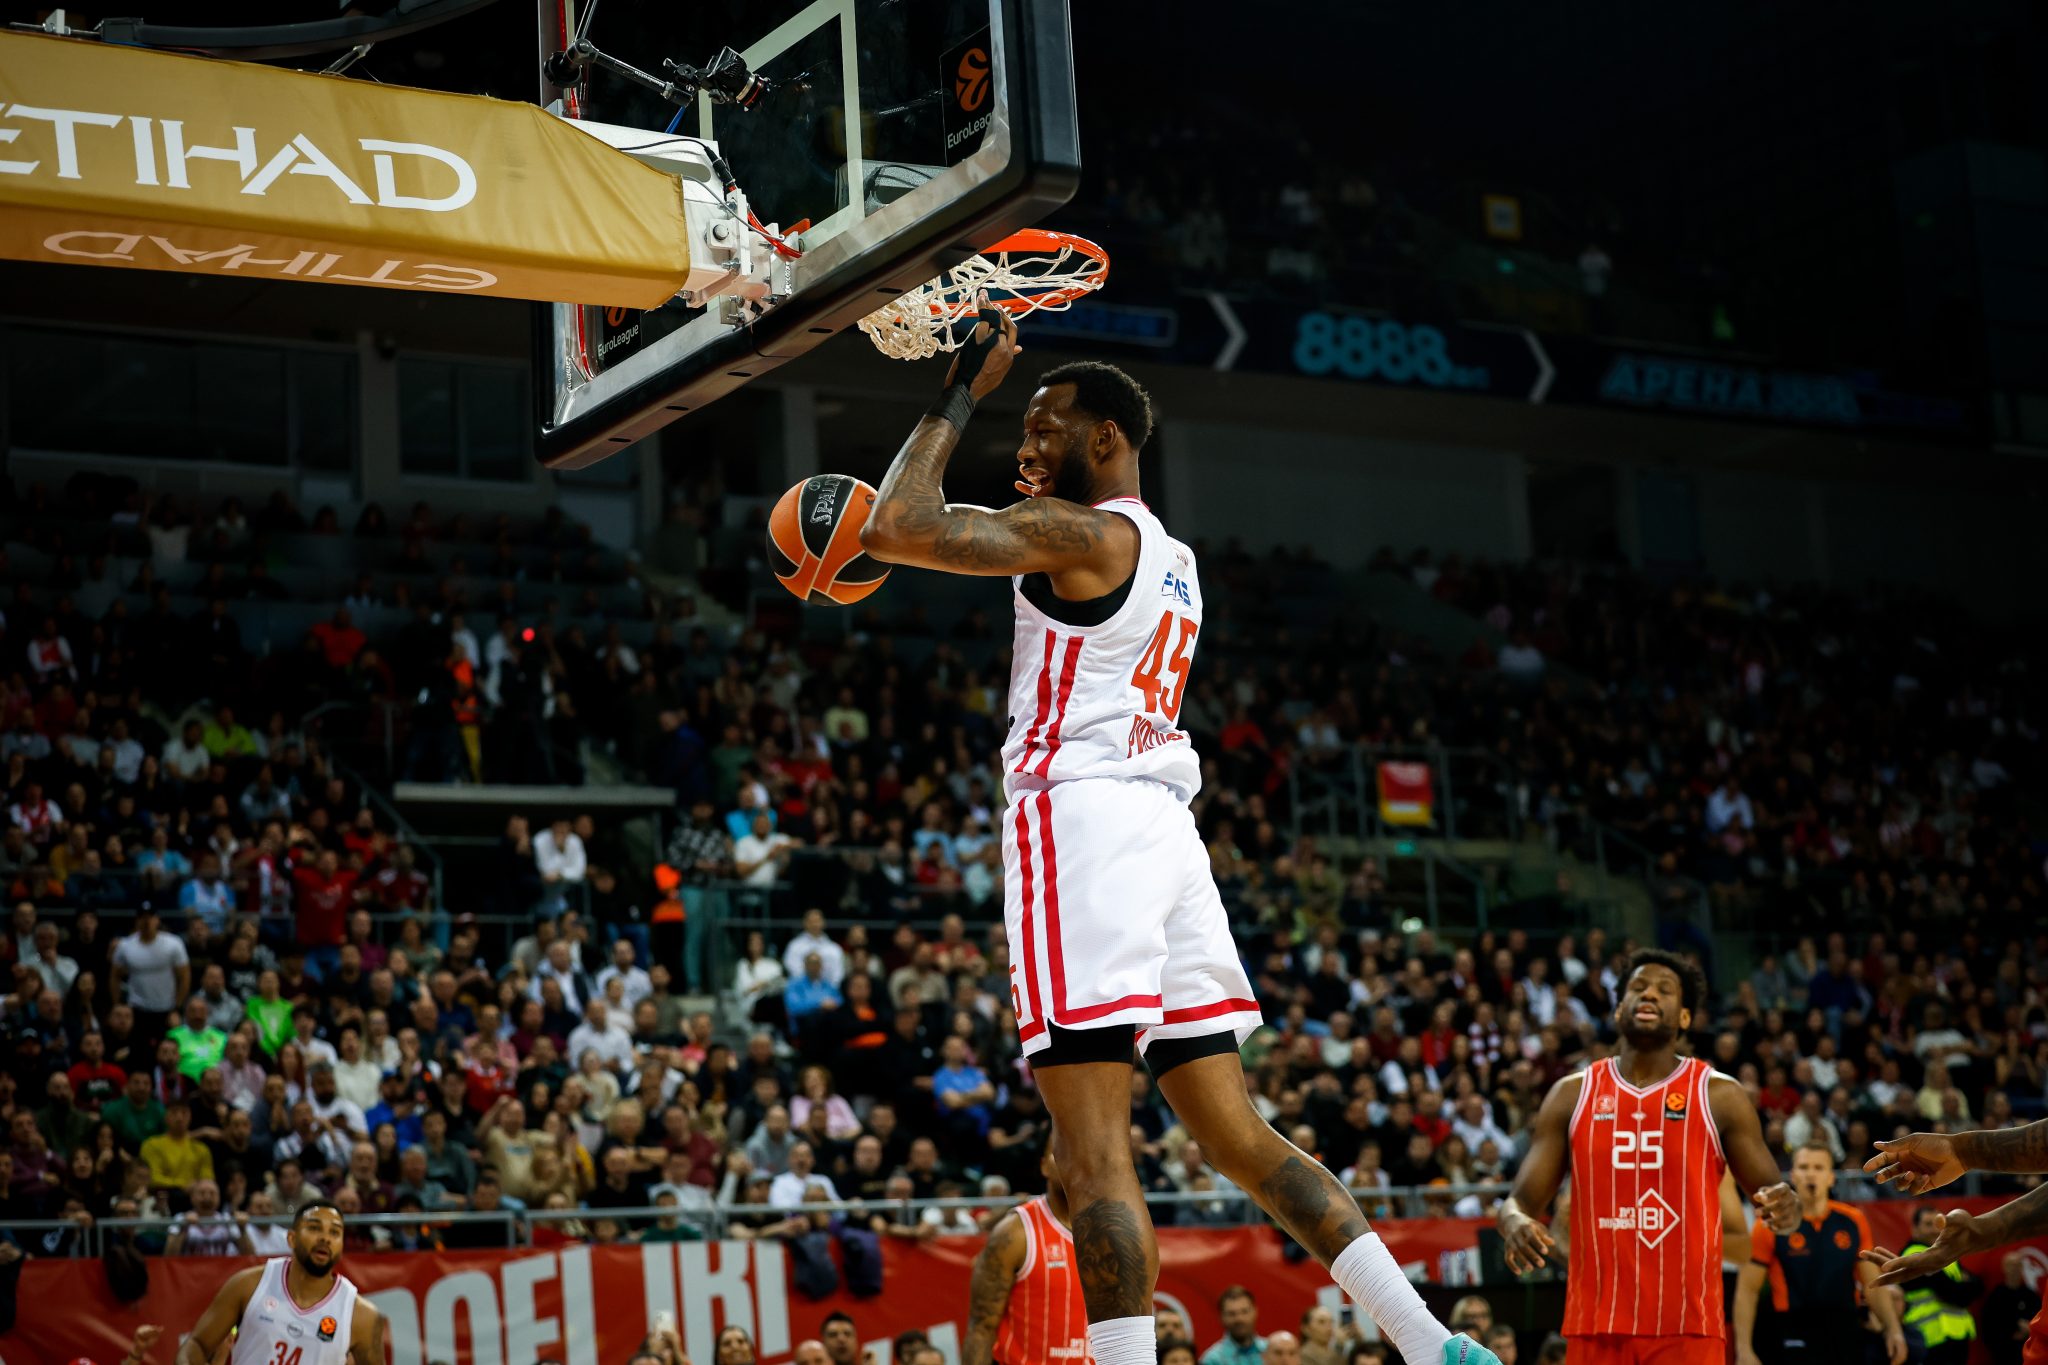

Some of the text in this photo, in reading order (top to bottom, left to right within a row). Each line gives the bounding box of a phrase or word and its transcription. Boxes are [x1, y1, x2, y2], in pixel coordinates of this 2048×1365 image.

[43, 231, 498, 291] ETIHAD
[597, 324, 640, 358] EuroLeague
[1131, 610, 1198, 722] 45
[1611, 1130, 1664, 1170] 25
[1638, 1207, 1664, 1230] IBI
[269, 1340, 303, 1365] 34
